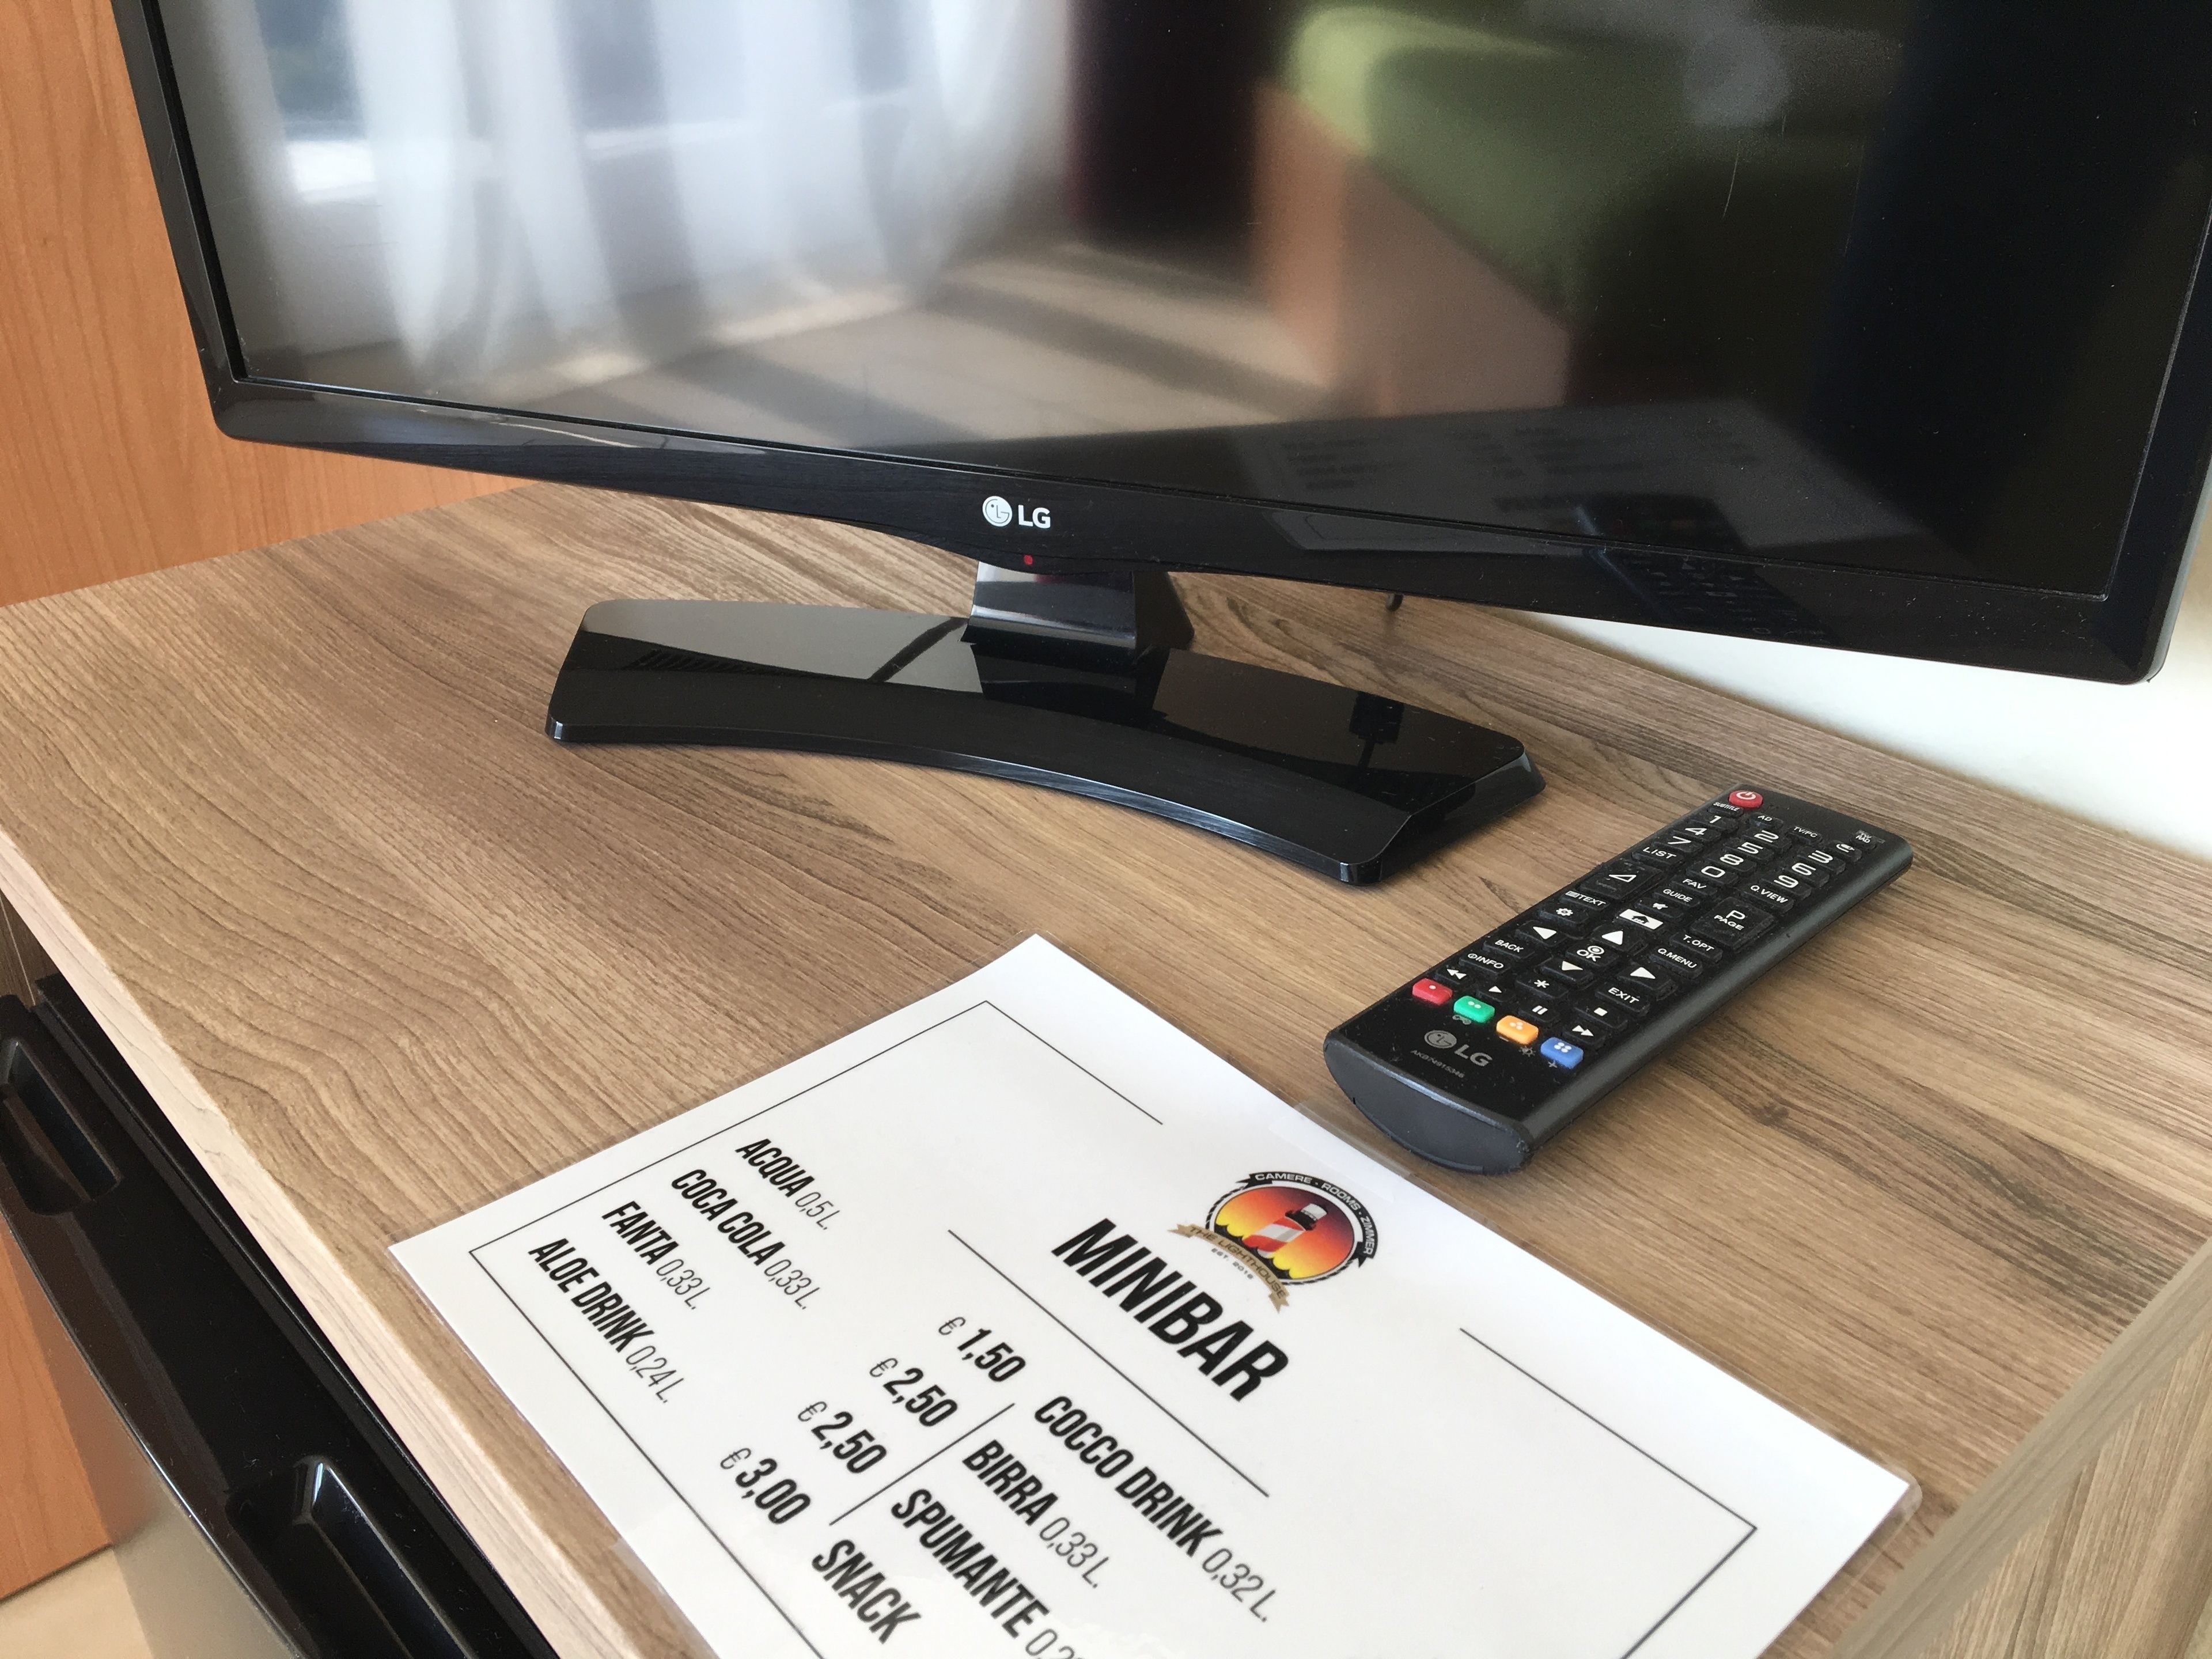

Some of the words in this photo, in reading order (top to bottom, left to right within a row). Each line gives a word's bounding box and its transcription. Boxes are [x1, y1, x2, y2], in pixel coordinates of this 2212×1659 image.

[1018, 505, 1051, 529] LG
[1713, 802, 1740, 811] SUBTITLE
[1709, 815, 1721, 824] 1
[1668, 836, 1691, 845] 7
[1684, 827, 1707, 836] 4
[1753, 830, 1779, 843] 2
[1793, 825, 1818, 838] TV/PC
[1642, 846, 1677, 859] LIST
[1737, 842, 1763, 854] 5
[1808, 850, 1833, 863] 3
[1719, 854, 1744, 865] 8
[1700, 865, 1726, 878] 0
[1791, 862, 1816, 876] 6
[1682, 878, 1707, 889] FAV
[1774, 874, 1798, 888] 9
[1577, 893, 1606, 907] TEXT
[1662, 888, 1693, 903] GUIDE
[1750, 884, 1788, 904] Q.VIEW
[1713, 914, 1745, 930] PAGE
[1726, 910, 1746, 921] P
[1494, 939, 1524, 953] BACK
[1683, 934, 1714, 952] T.OPT
[1576, 949, 1601, 962] OK
[1657, 948, 1697, 969] Q.MENU
[1608, 987, 1639, 1005] EXIT
[1454, 1044, 1493, 1066] LG
[734, 1138, 815, 1198] ACQUA
[671, 1169, 738, 1221] COCA
[717, 1211, 786, 1266] COLA
[1255, 1173, 1312, 1184] CAMERE
[1321, 1183, 1359, 1211] ROOMS
[1360, 1216, 1375, 1255] ZIMMER
[601, 1200, 679, 1266] FANTA
[1189, 1226, 1214, 1243] THE
[1218, 1238, 1287, 1300] LIGHTHOUSE
[528, 1238, 600, 1293] ALOE
[570, 1281, 655, 1353] DRINK
[1051, 1218, 1289, 1403] MINIBAR
[957, 1328, 1027, 1382] 1,50
[882, 1368, 958, 1427] 2,50
[811, 1411, 887, 1474] 2,50
[962, 1439, 1059, 1527] BIRRA
[1034, 1396, 1134, 1479] COCCO
[1115, 1466, 1224, 1558] DRINK
[735, 1458, 811, 1525] 3,00
[891, 1488, 1050, 1639] SPUMANTE
[812, 1539, 922, 1644] SNACK
